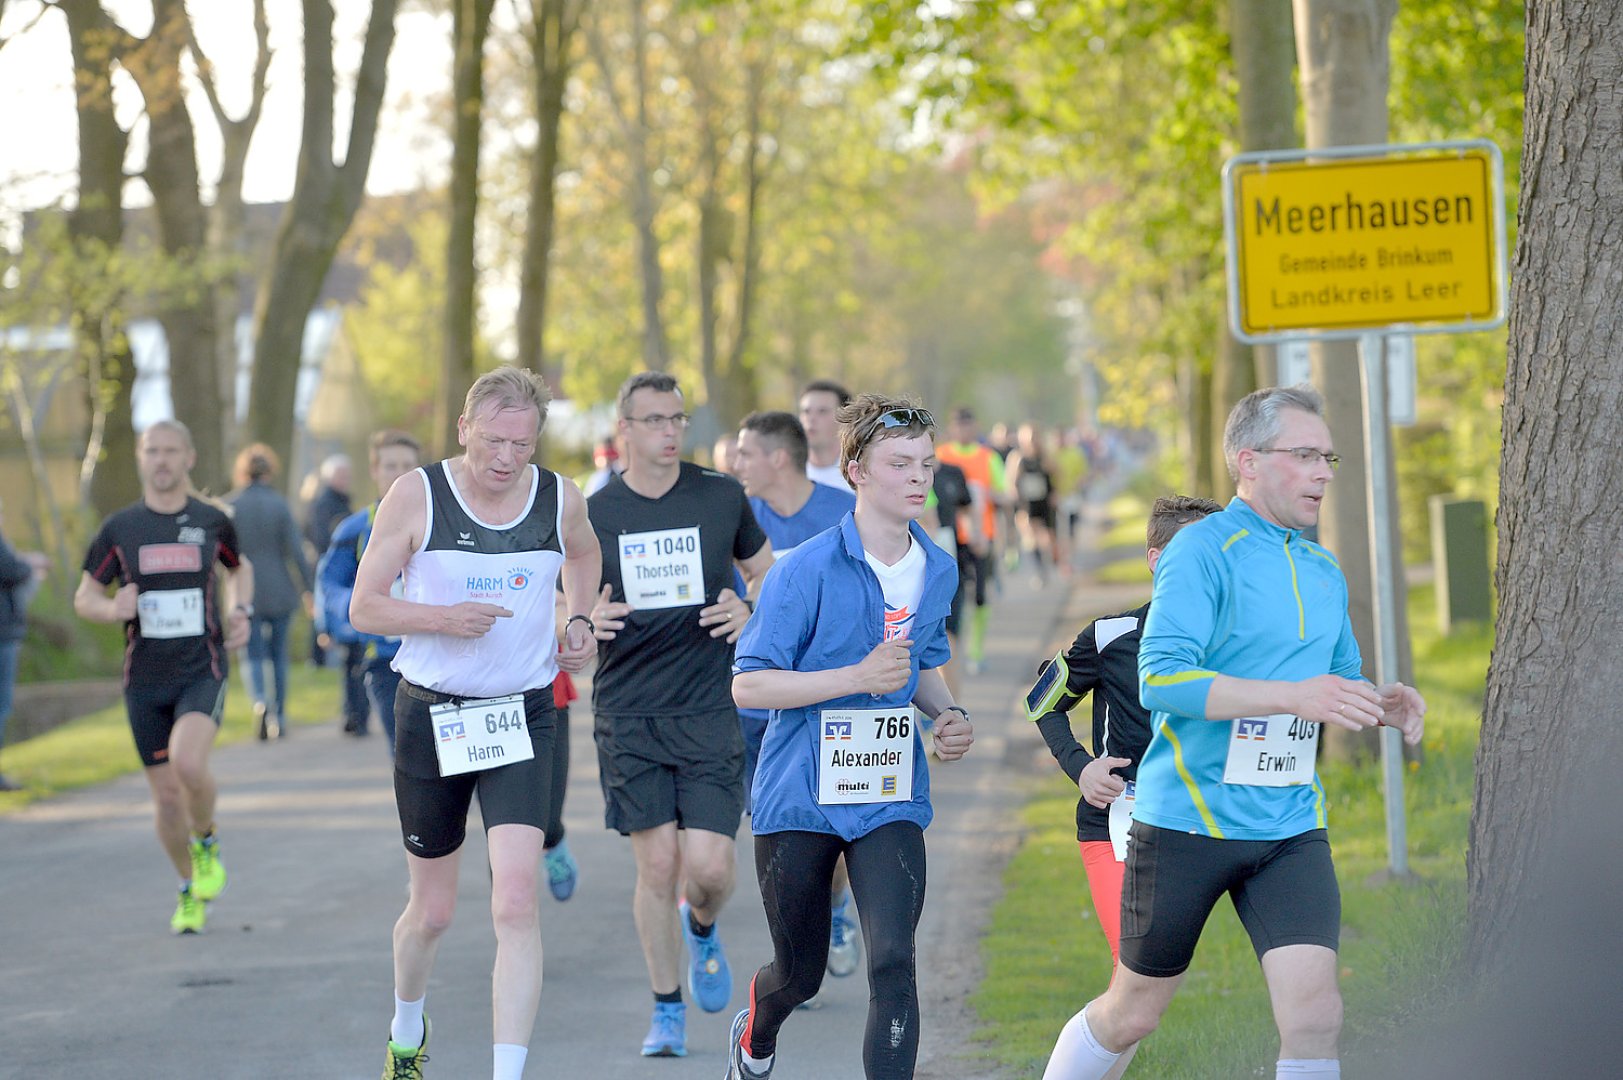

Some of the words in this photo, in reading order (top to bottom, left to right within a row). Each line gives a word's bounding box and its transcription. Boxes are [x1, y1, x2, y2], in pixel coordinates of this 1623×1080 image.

[1255, 191, 1473, 236] Meerhausen
[1279, 250, 1368, 275] Gemeinde
[1377, 245, 1453, 269] Brinkum
[1271, 281, 1393, 309] Landkreis
[1406, 278, 1462, 300] Leer
[653, 536, 695, 555] 1040
[635, 563, 689, 579] Thorsten
[467, 577, 503, 590] HARM
[485, 710, 522, 734] 644
[874, 716, 910, 739] 766
[1288, 717, 1315, 741] 403
[467, 745, 504, 762] Harm
[831, 748, 902, 767] Alexander
[1257, 752, 1296, 771] Erwin
[838, 782, 869, 791] multi
